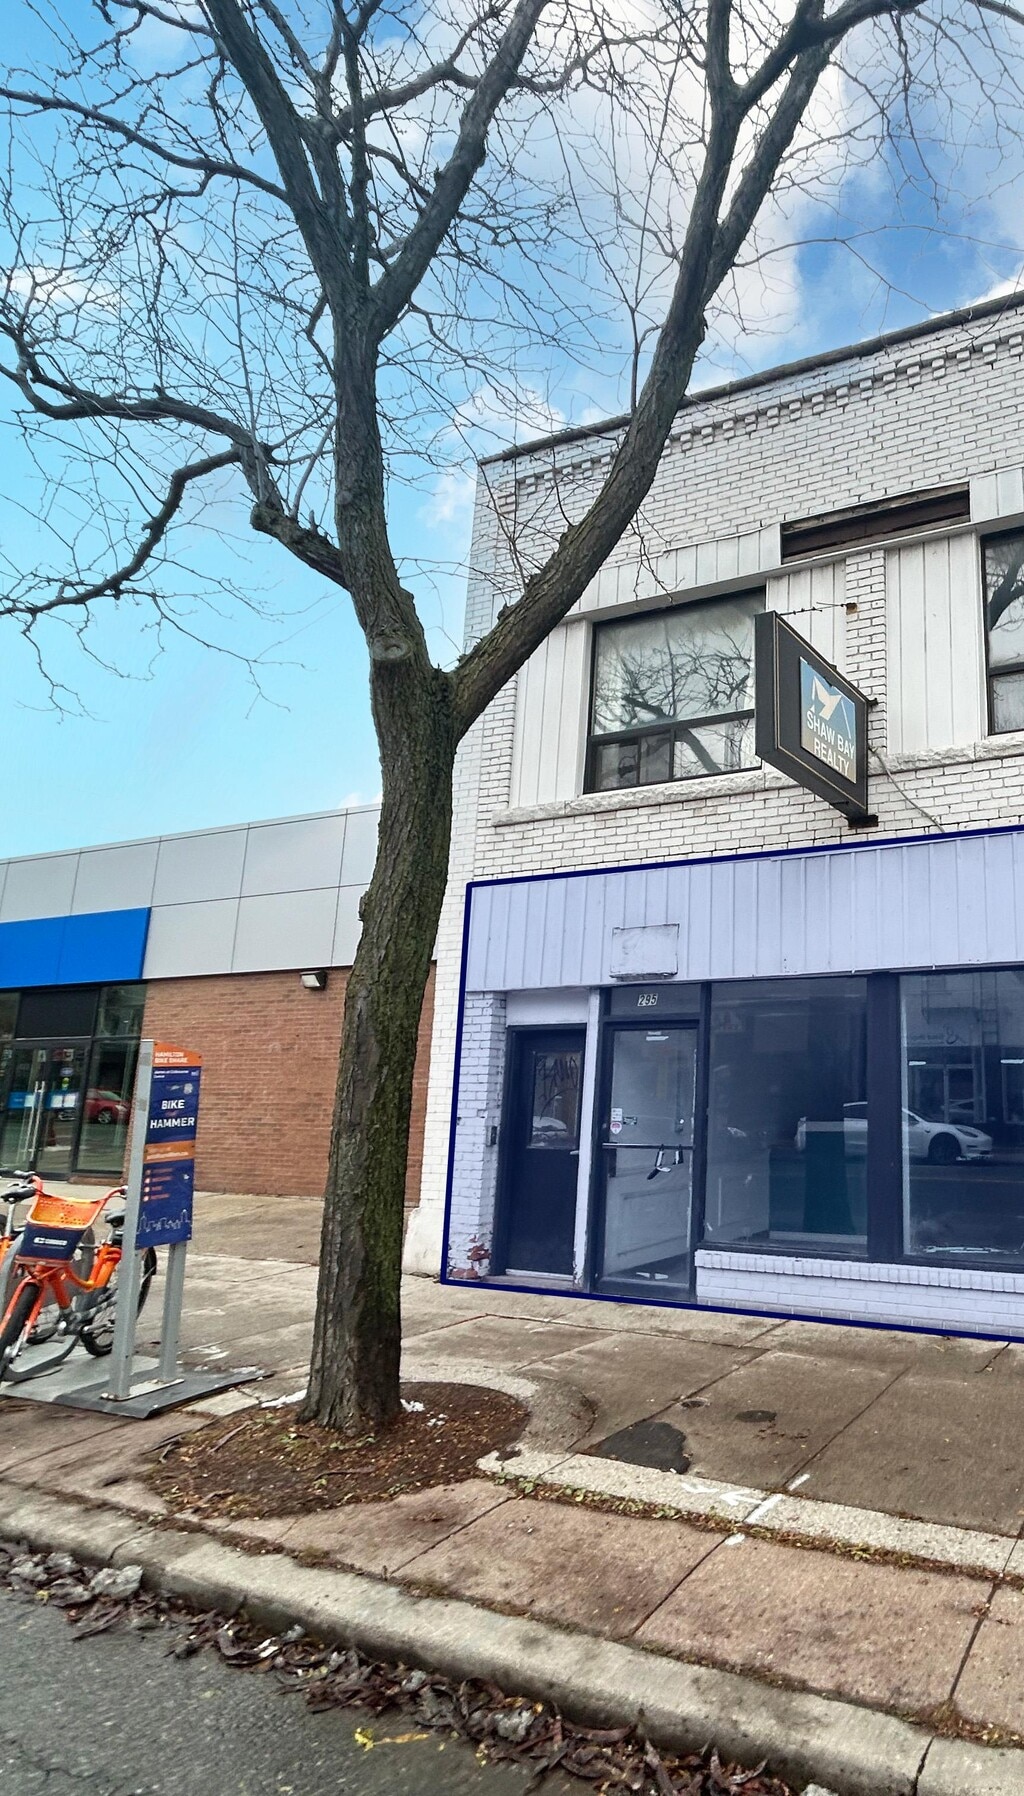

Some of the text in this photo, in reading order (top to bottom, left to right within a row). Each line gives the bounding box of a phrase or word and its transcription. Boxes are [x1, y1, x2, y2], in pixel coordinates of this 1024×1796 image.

[806, 710, 855, 760] SHAW BAY
[814, 737, 850, 777] REALTY
[638, 993, 658, 1006] 295
[161, 1099, 185, 1109] BIKE
[150, 1117, 195, 1128] HAMMER
